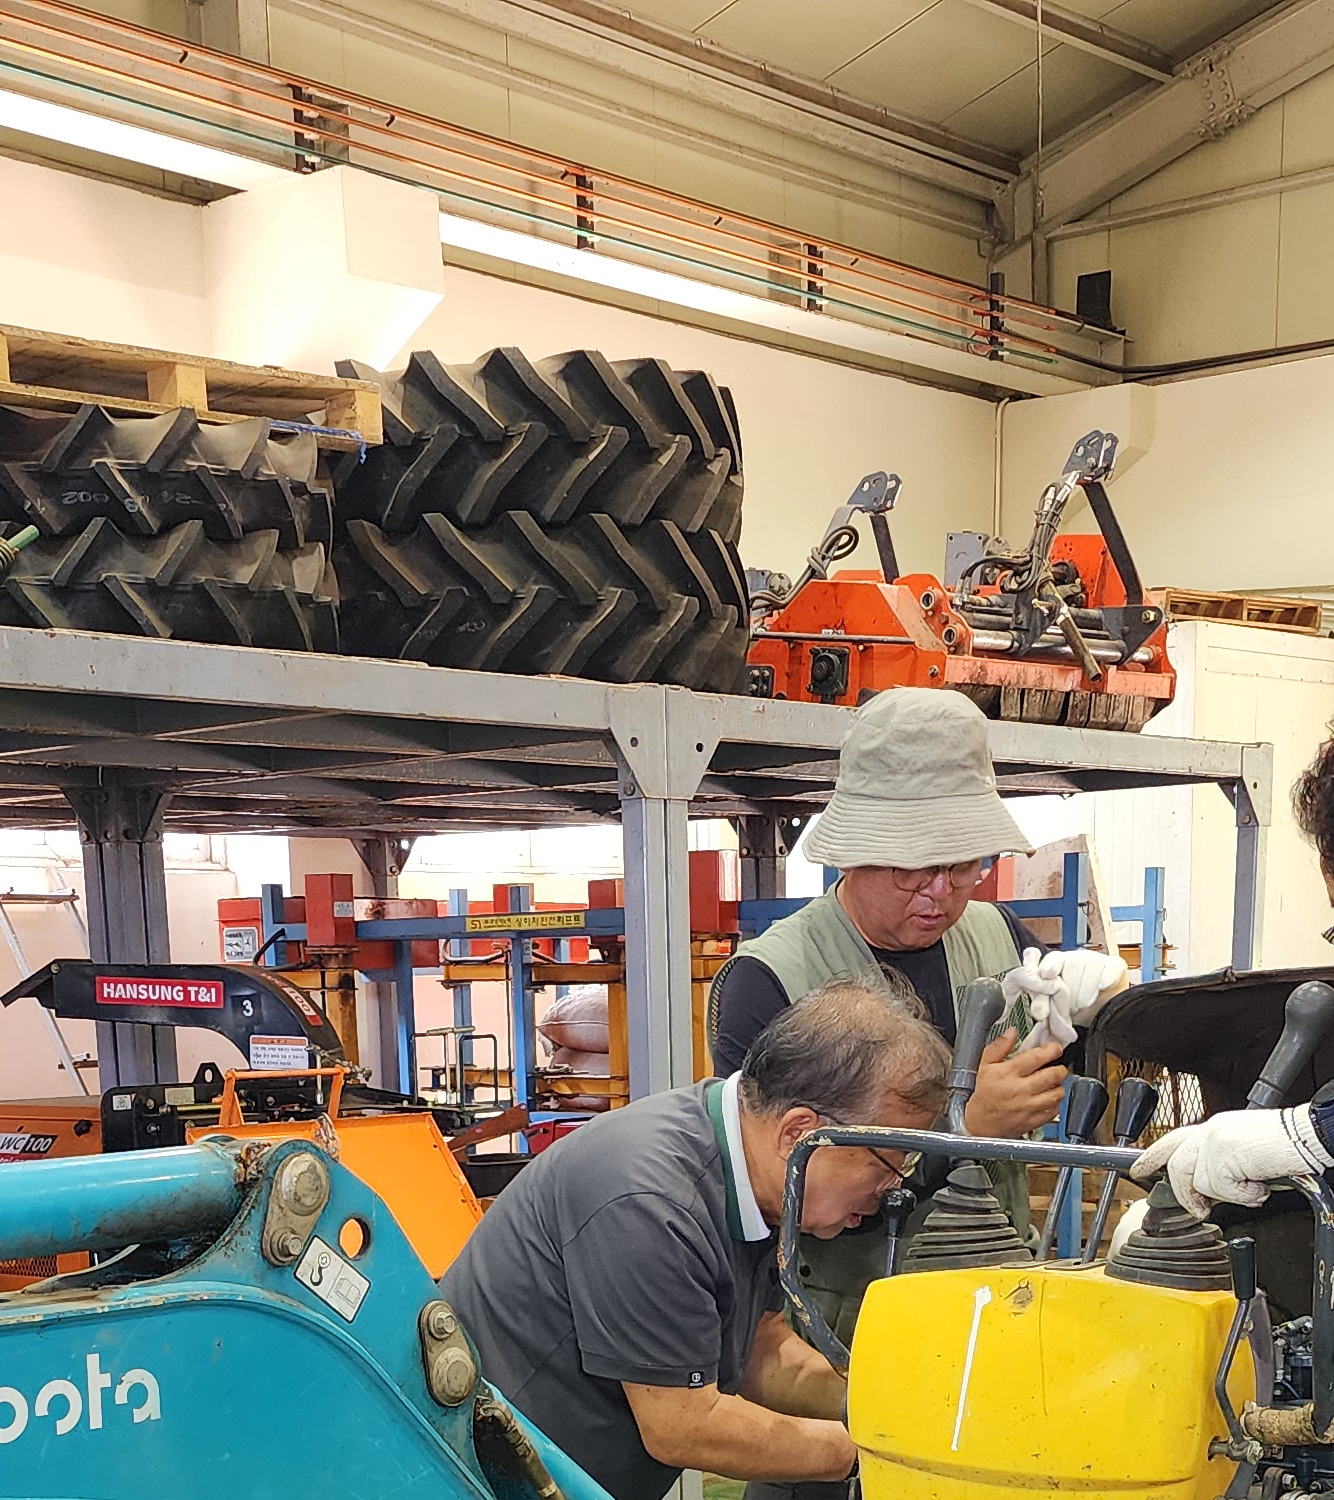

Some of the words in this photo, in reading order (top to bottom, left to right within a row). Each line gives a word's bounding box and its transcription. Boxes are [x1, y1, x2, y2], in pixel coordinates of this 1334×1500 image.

[103, 982, 184, 1001] HANSUNG
[187, 986, 216, 1003] T&I
[242, 999, 253, 1017] 3
